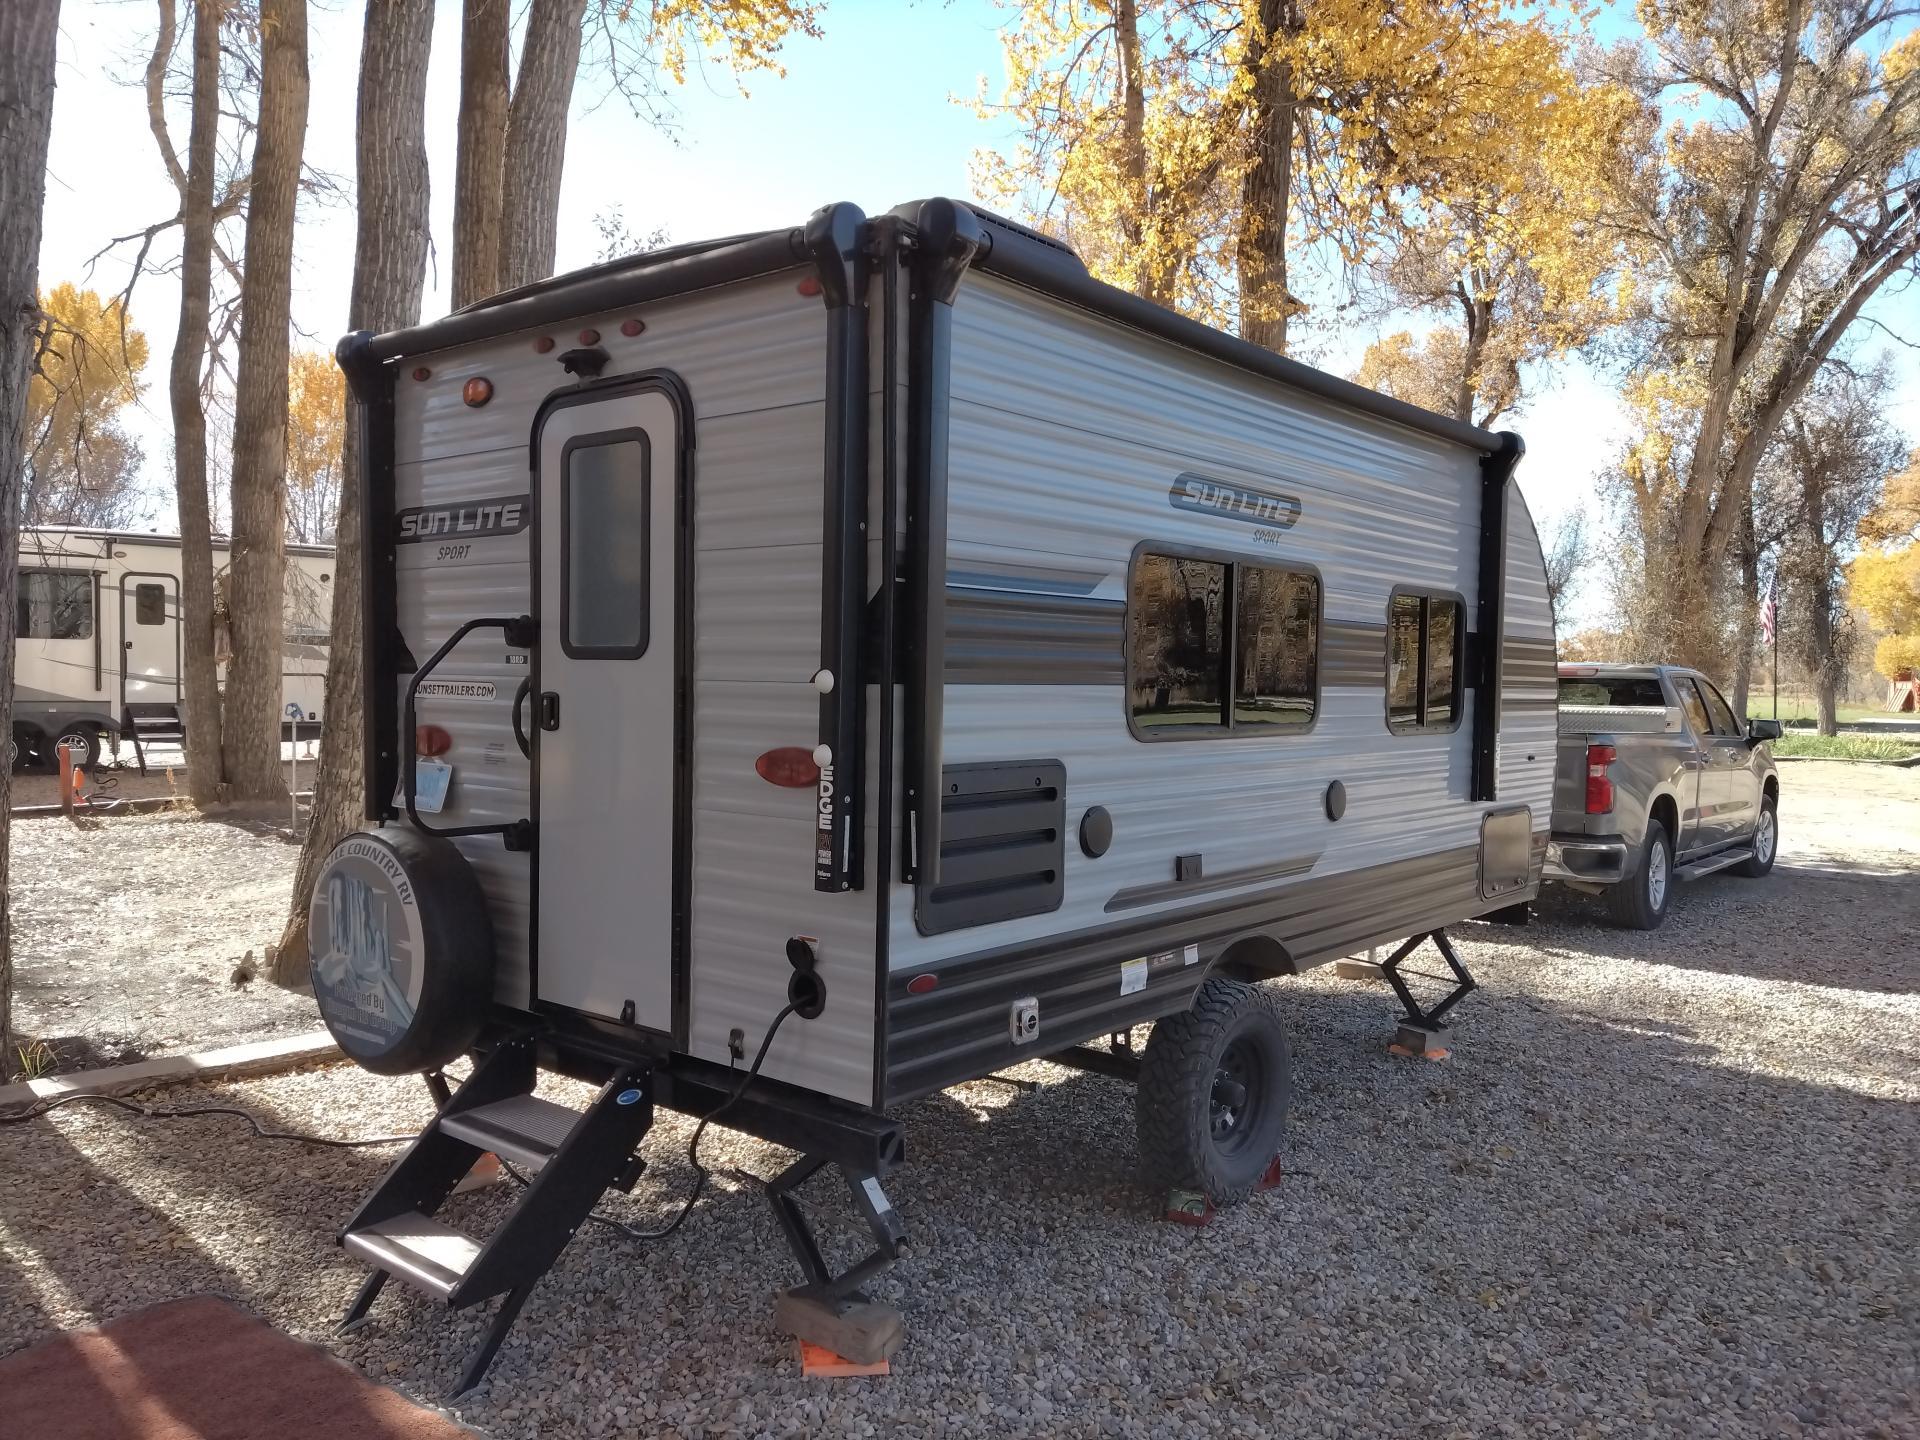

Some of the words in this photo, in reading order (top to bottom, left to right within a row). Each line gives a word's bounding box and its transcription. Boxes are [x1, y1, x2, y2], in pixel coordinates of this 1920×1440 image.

[1182, 481, 1236, 511] SUN
[1239, 493, 1292, 522] LITE
[400, 511, 451, 537] SUN
[457, 504, 522, 531] LITE
[1252, 529, 1283, 546] SPORT
[437, 545, 472, 560] SPORT
[414, 683, 495, 698] UNSETTRAILERS.COM
[819, 765, 833, 829] EDGE
[347, 843, 403, 879] COUNTRY
[397, 881, 413, 905] RV
[373, 992, 385, 1013] By
